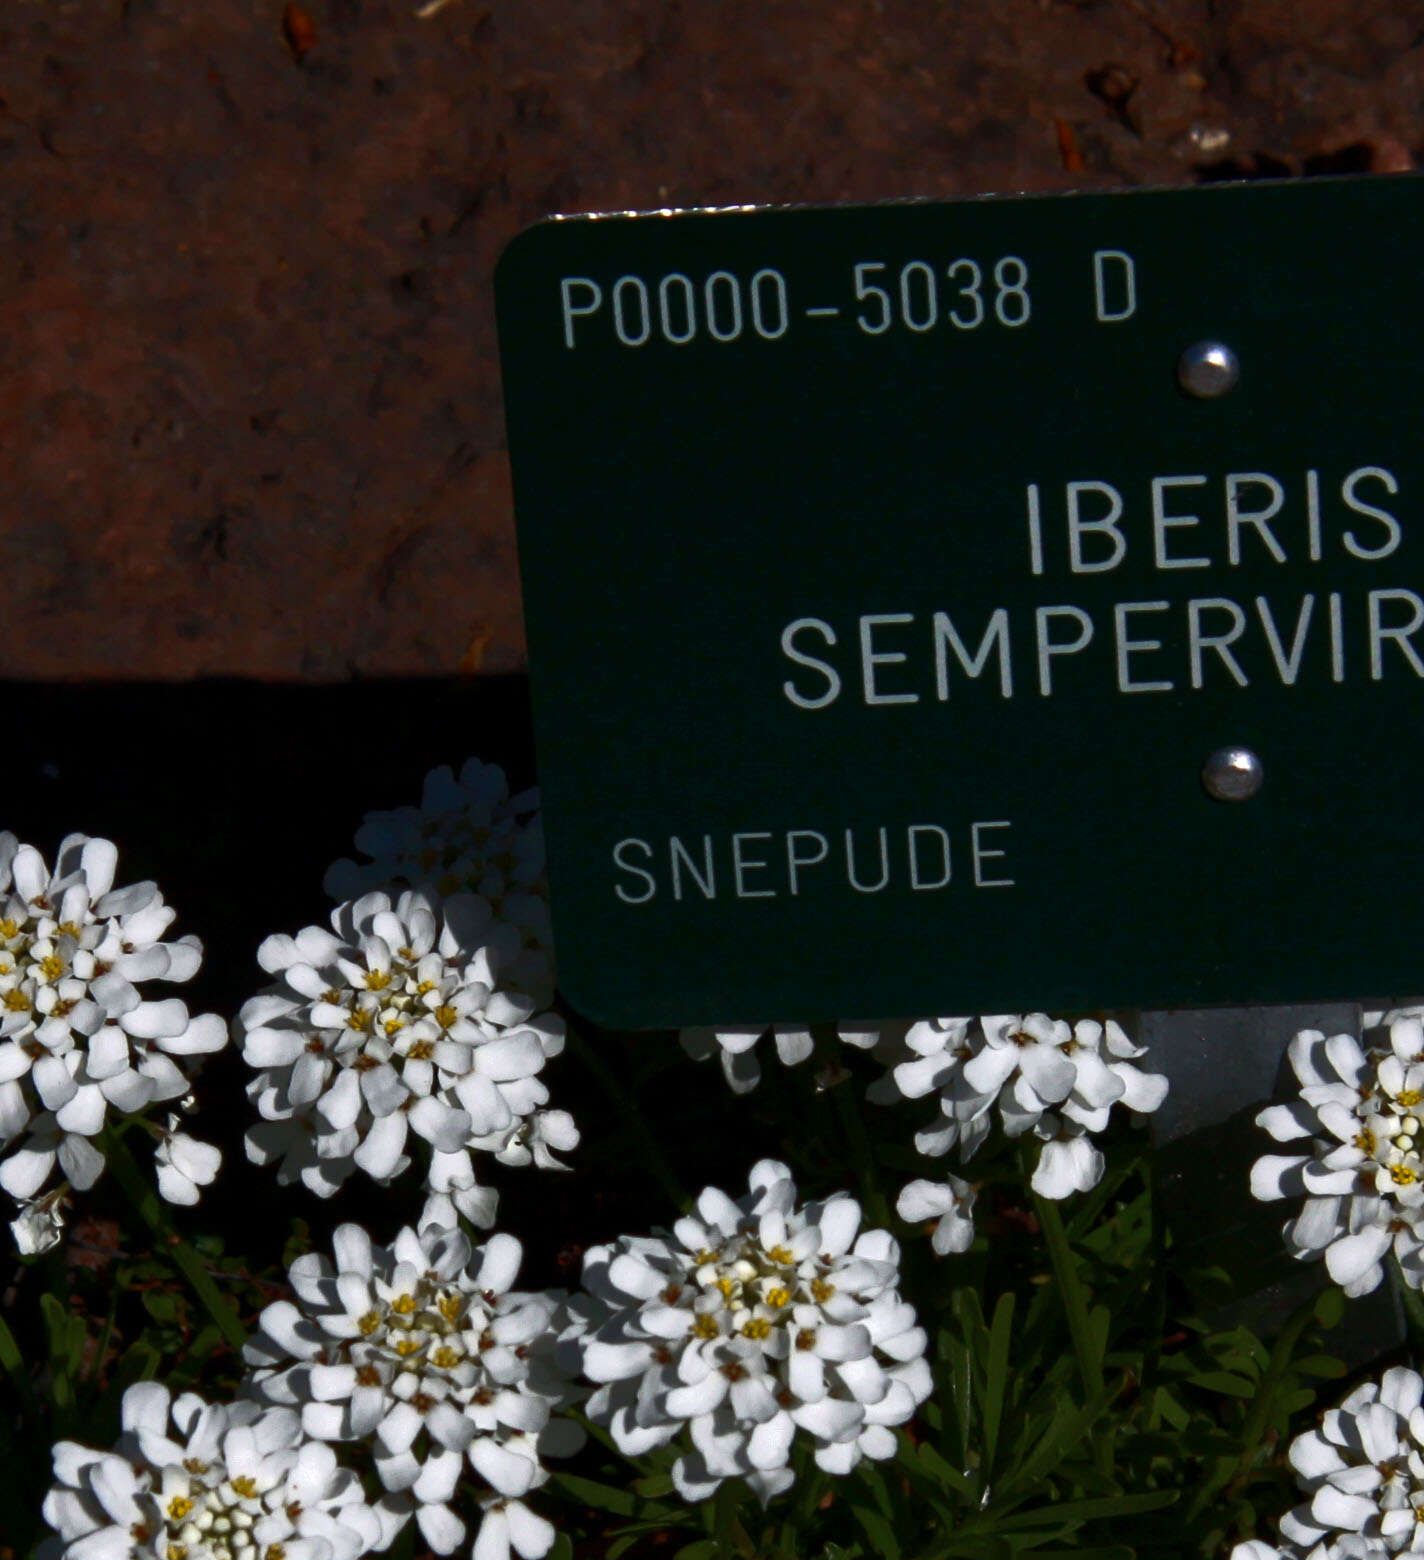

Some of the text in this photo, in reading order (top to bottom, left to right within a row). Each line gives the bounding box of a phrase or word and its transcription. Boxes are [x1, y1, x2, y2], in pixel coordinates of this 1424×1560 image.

[560, 251, 1136, 348] P0000-5038 D
[1025, 465, 1403, 576] IBERIS
[612, 820, 1016, 905] SNEPUDE
